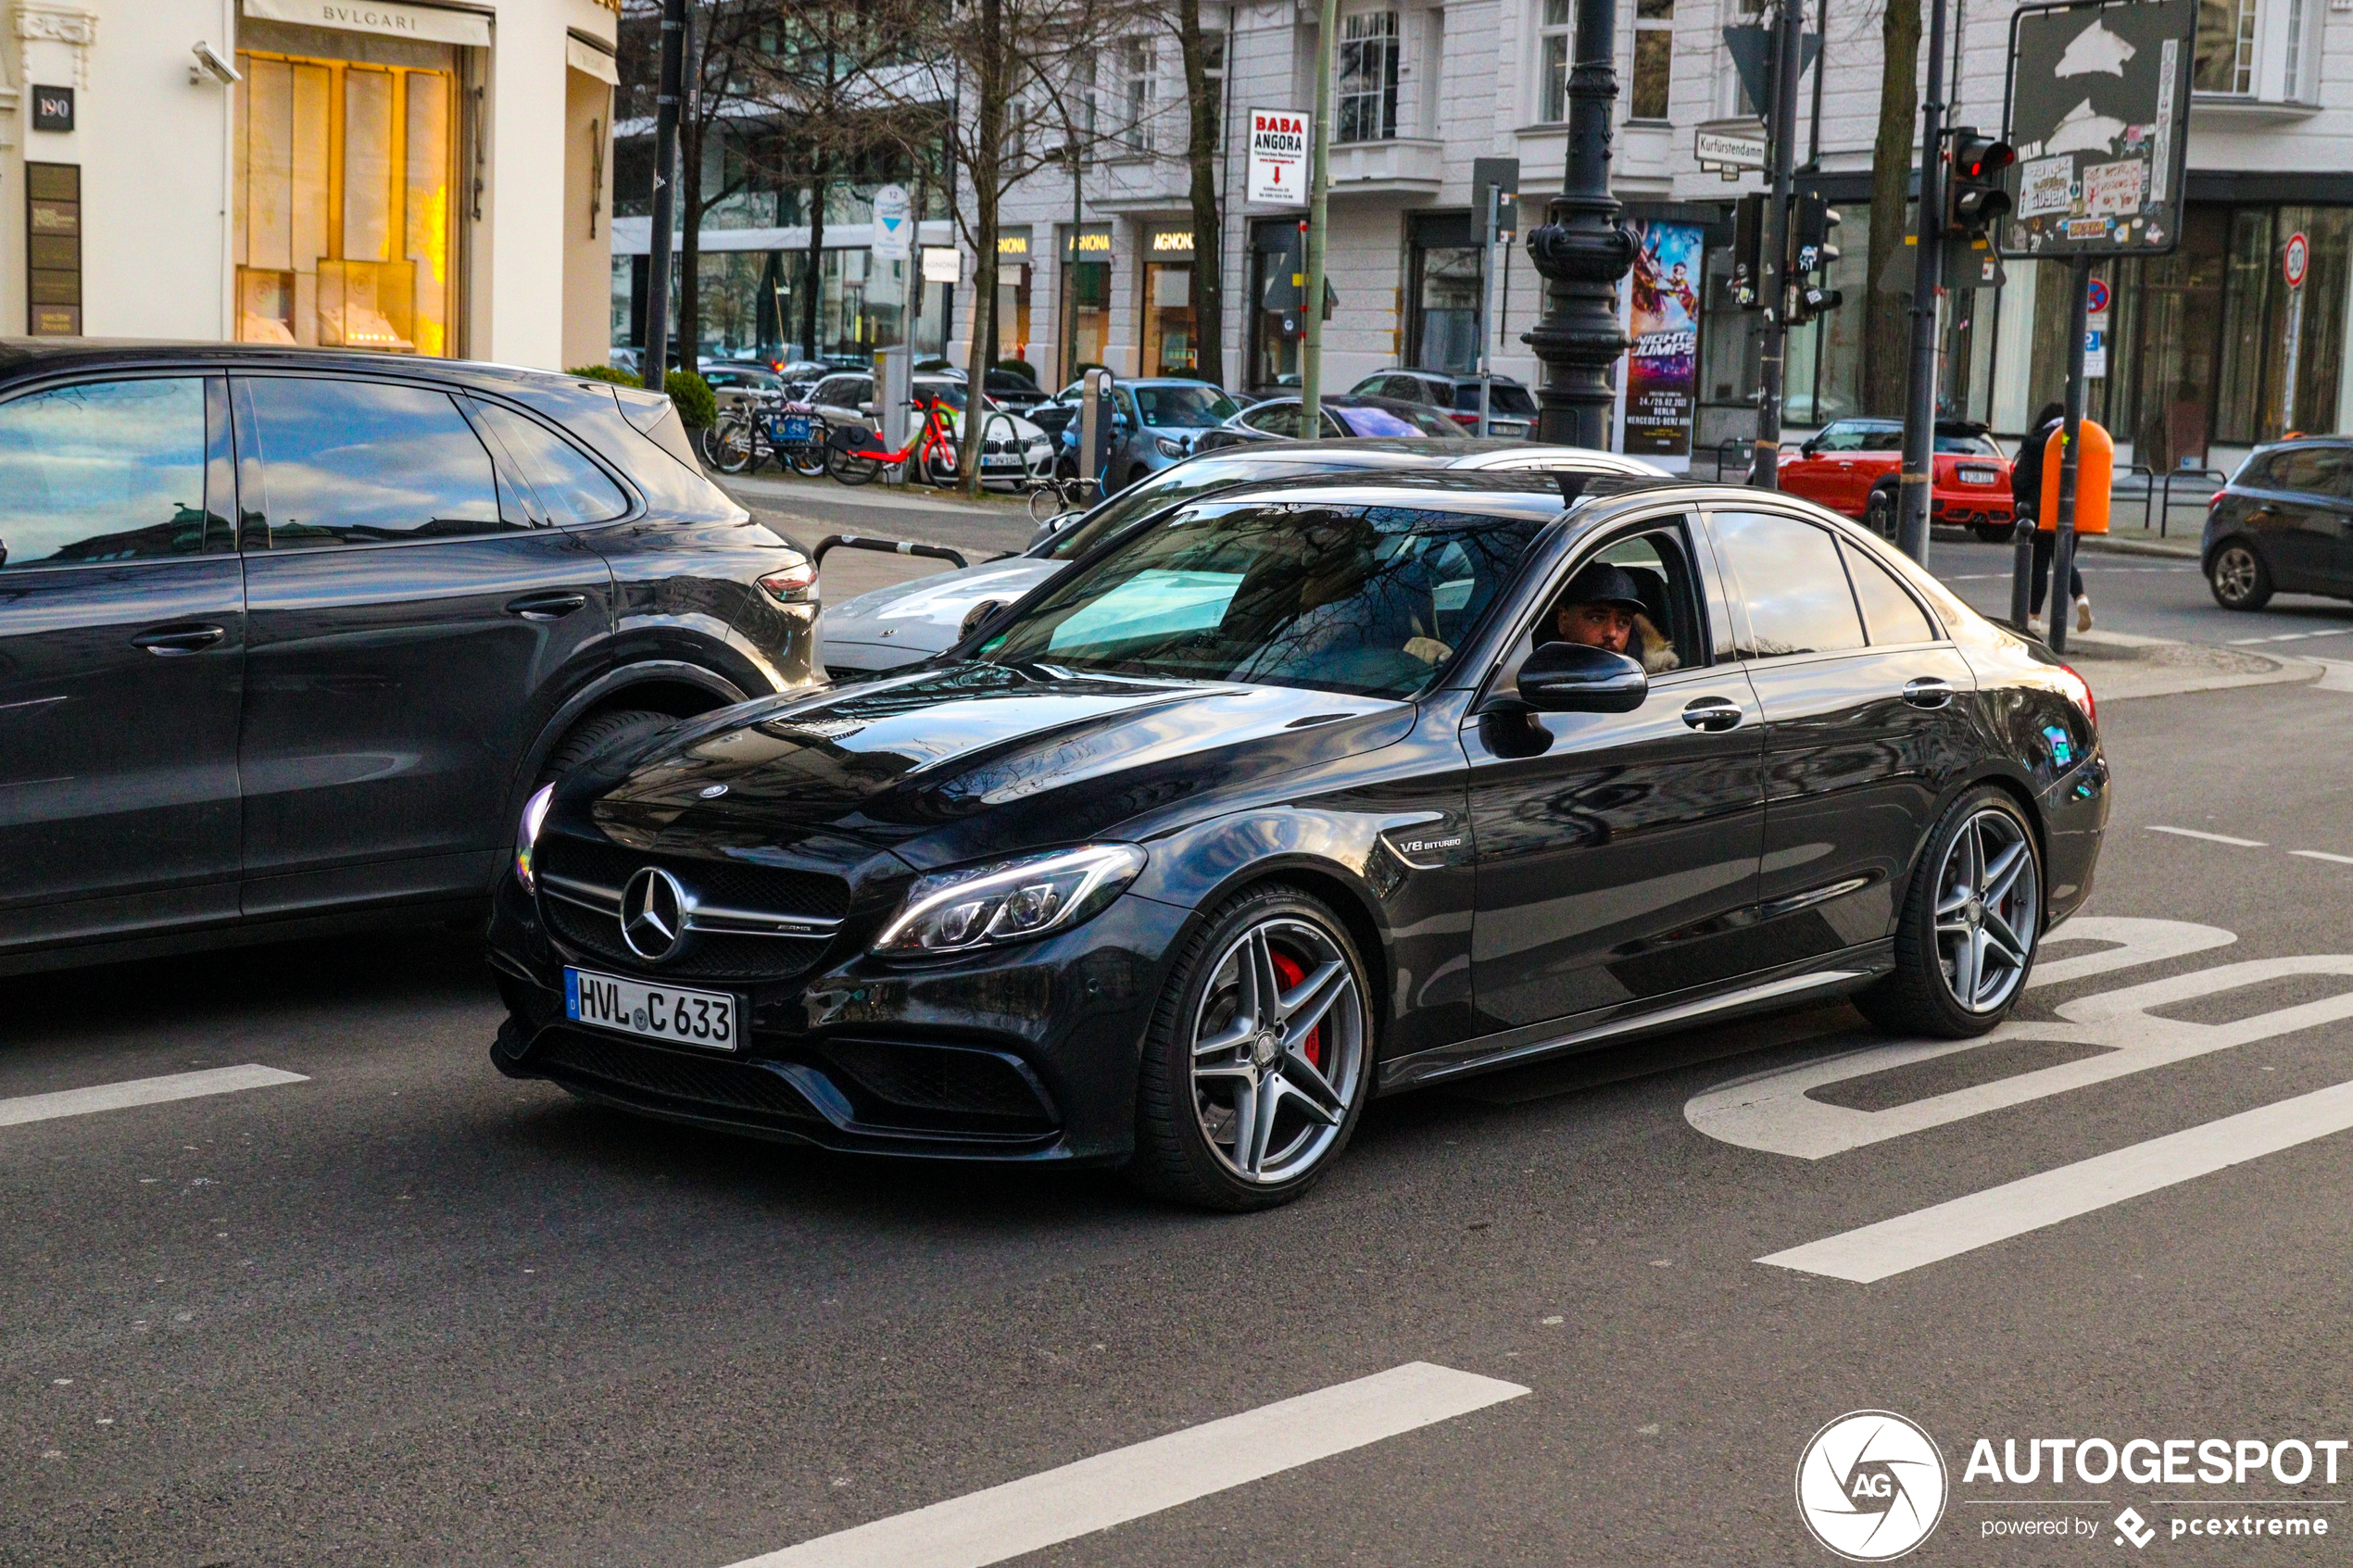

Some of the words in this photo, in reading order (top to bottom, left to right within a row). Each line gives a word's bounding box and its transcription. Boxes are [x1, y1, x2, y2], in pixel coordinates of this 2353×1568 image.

[323, 6, 415, 31] BVLGARI
[41, 98, 69, 118] 190
[1255, 116, 1302, 134] BABA
[1254, 133, 1302, 151] ANGORA
[1701, 137, 1763, 157] Kurfürstendamm
[2018, 140, 2042, 163] MLM
[1153, 232, 1195, 250] AGNON
[2290, 248, 2302, 271] 30
[1631, 342, 1694, 357] JUMPS
[1654, 408, 1676, 416] BERLIN
[1400, 841, 1422, 853] V8
[1424, 838, 1461, 850] BITURBO
[579, 977, 630, 1024] HVL
[648, 992, 666, 1031] C
[674, 996, 730, 1041] 633
